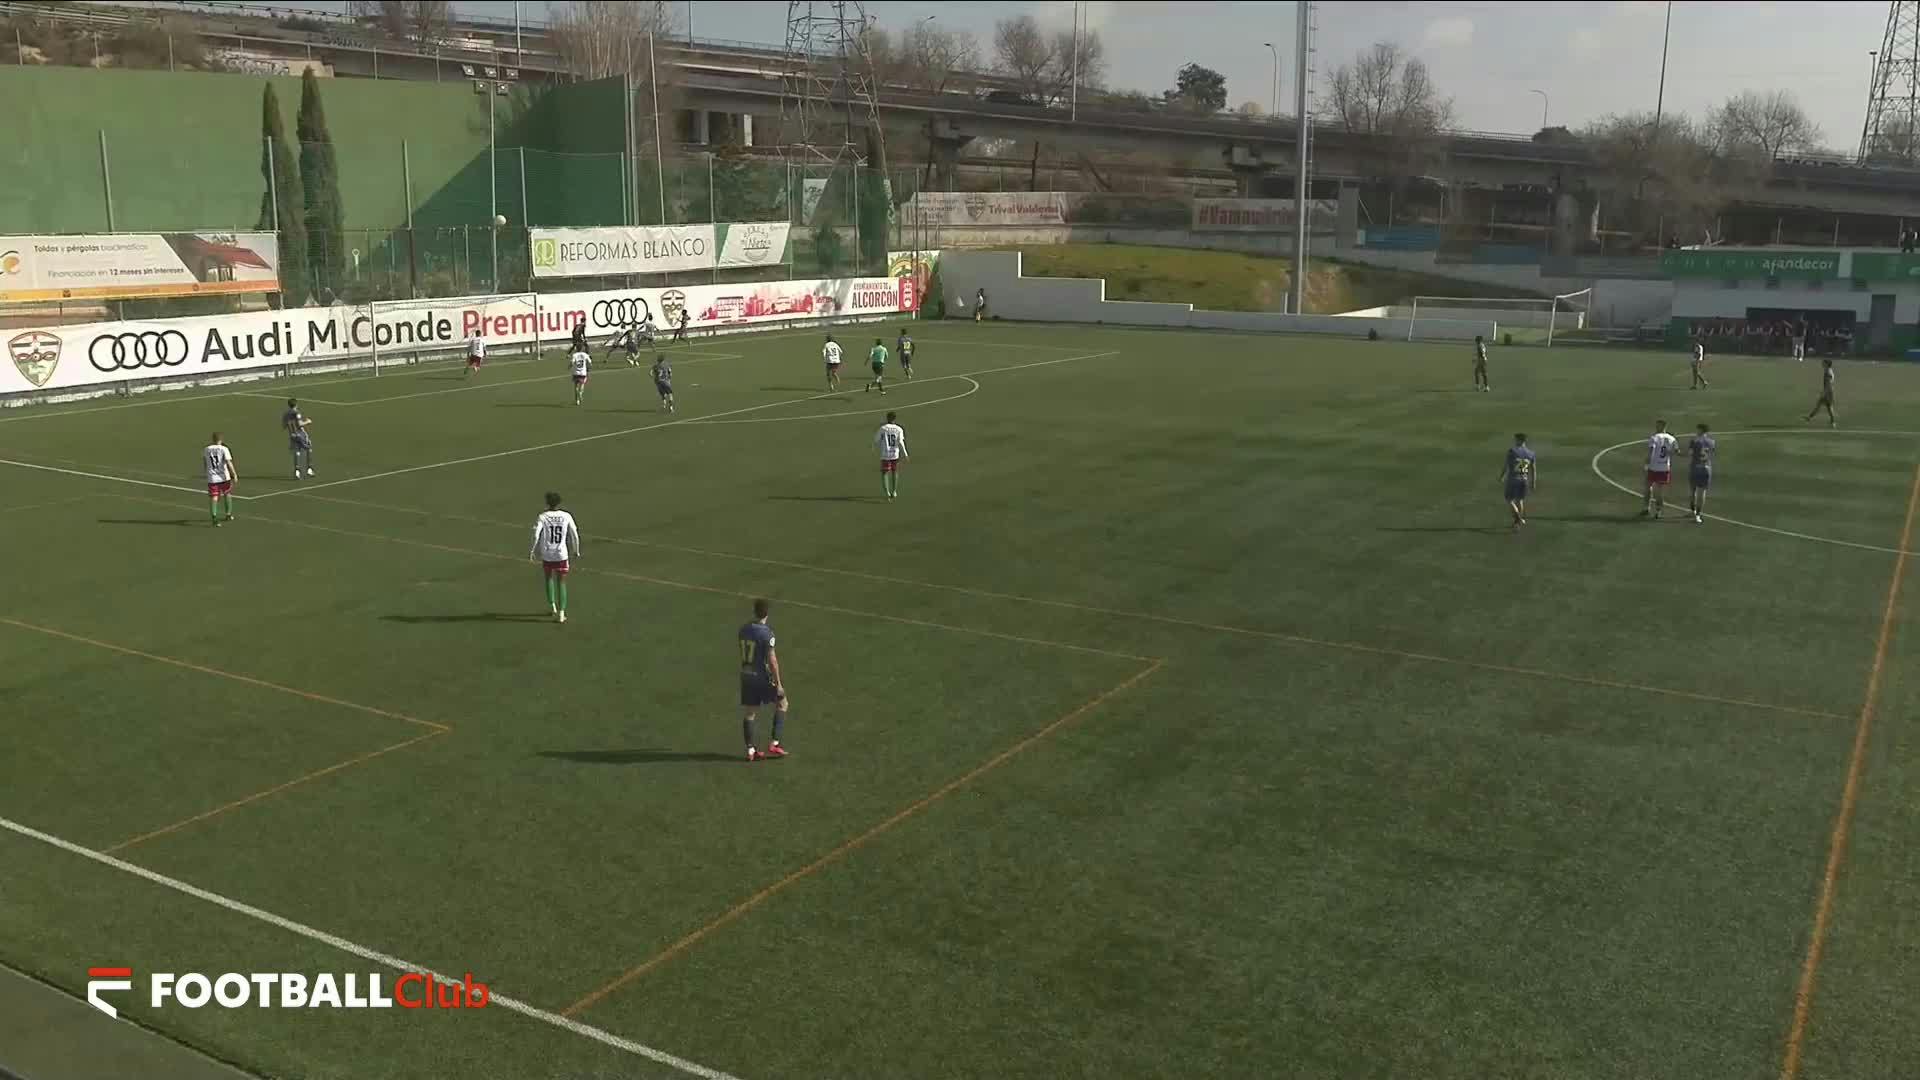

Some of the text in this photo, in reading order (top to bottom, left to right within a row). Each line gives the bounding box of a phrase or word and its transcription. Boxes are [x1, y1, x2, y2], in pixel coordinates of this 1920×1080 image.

[34, 244, 59, 253] Toldos
[560, 238, 706, 262] REFORMAS BLANCO
[143, 267, 153, 275] sin
[201, 306, 586, 363] Audi M.Conde Premium
